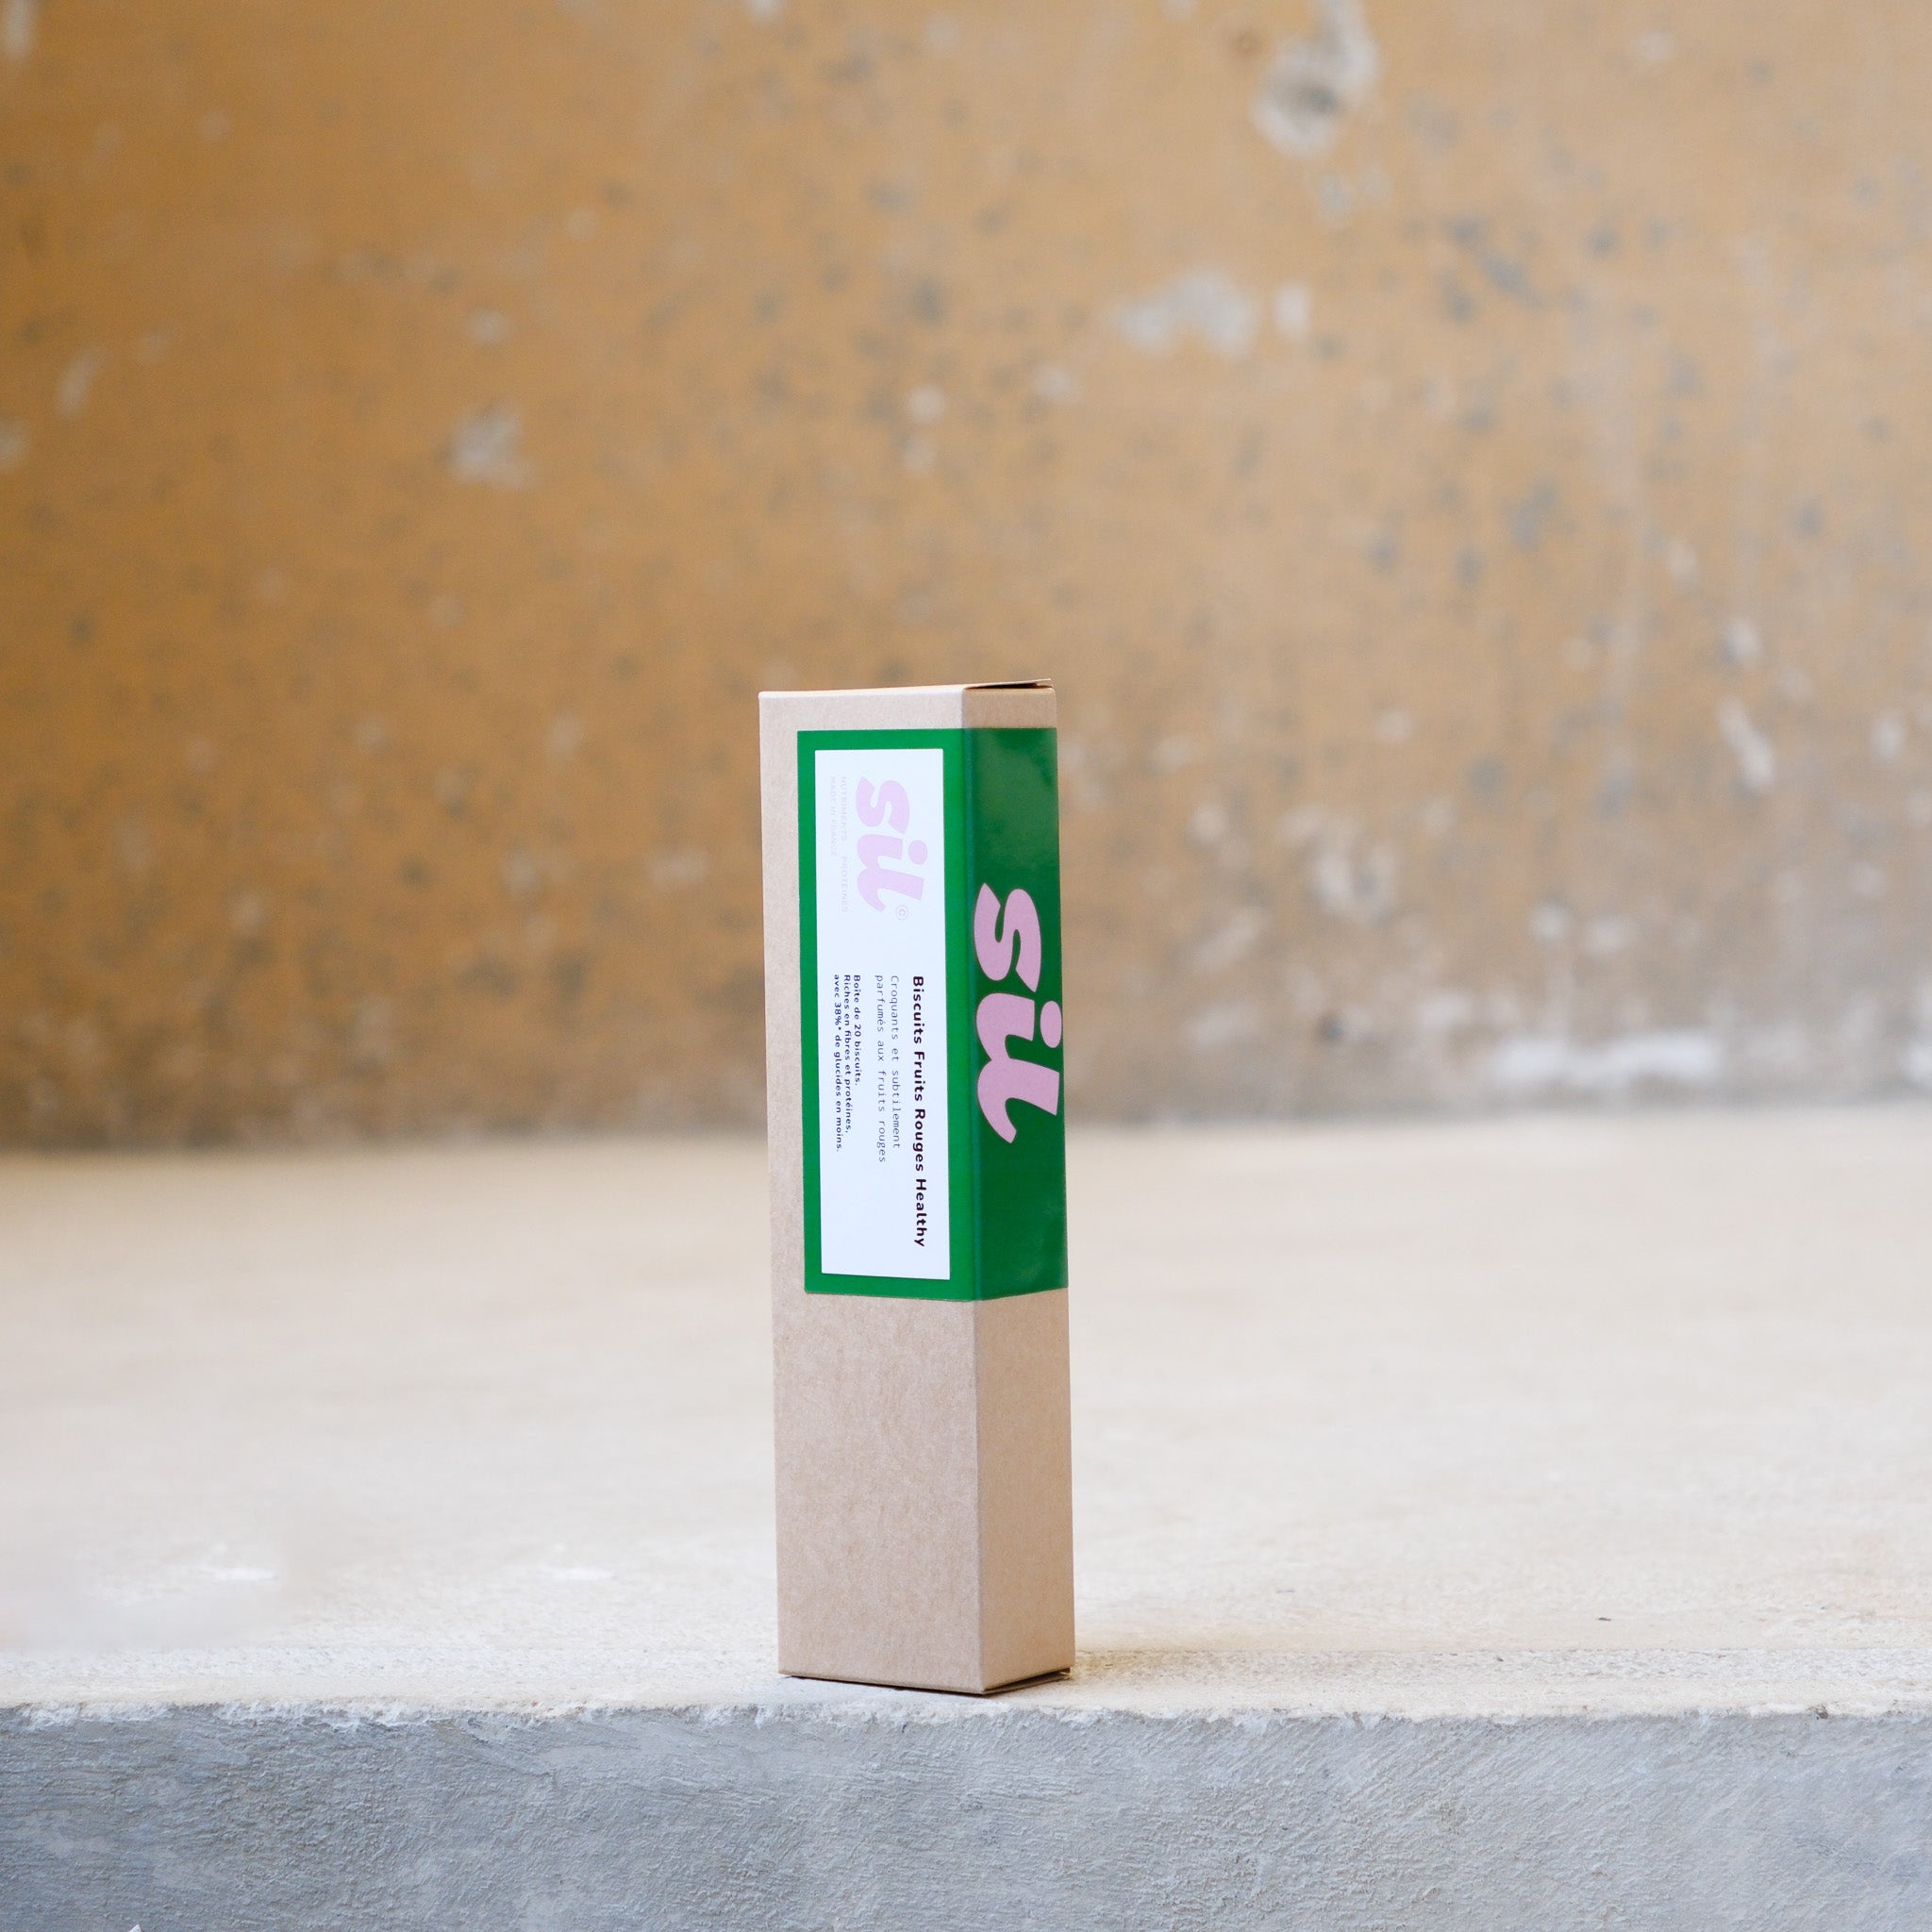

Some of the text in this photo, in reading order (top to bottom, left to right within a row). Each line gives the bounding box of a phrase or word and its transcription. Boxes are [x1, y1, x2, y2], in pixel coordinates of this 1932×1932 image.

[856, 776, 928, 912] sil
[844, 1014, 850, 1026] en
[855, 1008, 860, 1020] de
[874, 975, 886, 1032] parfumés
[974, 882, 1062, 1143] sil
[835, 1035, 841, 1047] de
[855, 1024, 861, 1037] 20
[834, 1052, 842, 1096] glucides
[845, 1064, 851, 1074] et
[889, 975, 901, 1149] Croquants et subtilement
[836, 1101, 841, 1112] en
[877, 1071, 887, 1112] fruits
[913, 975, 927, 1247] Biscuits Fruits Rouges Healthy
[876, 1121, 887, 1162] rouges
